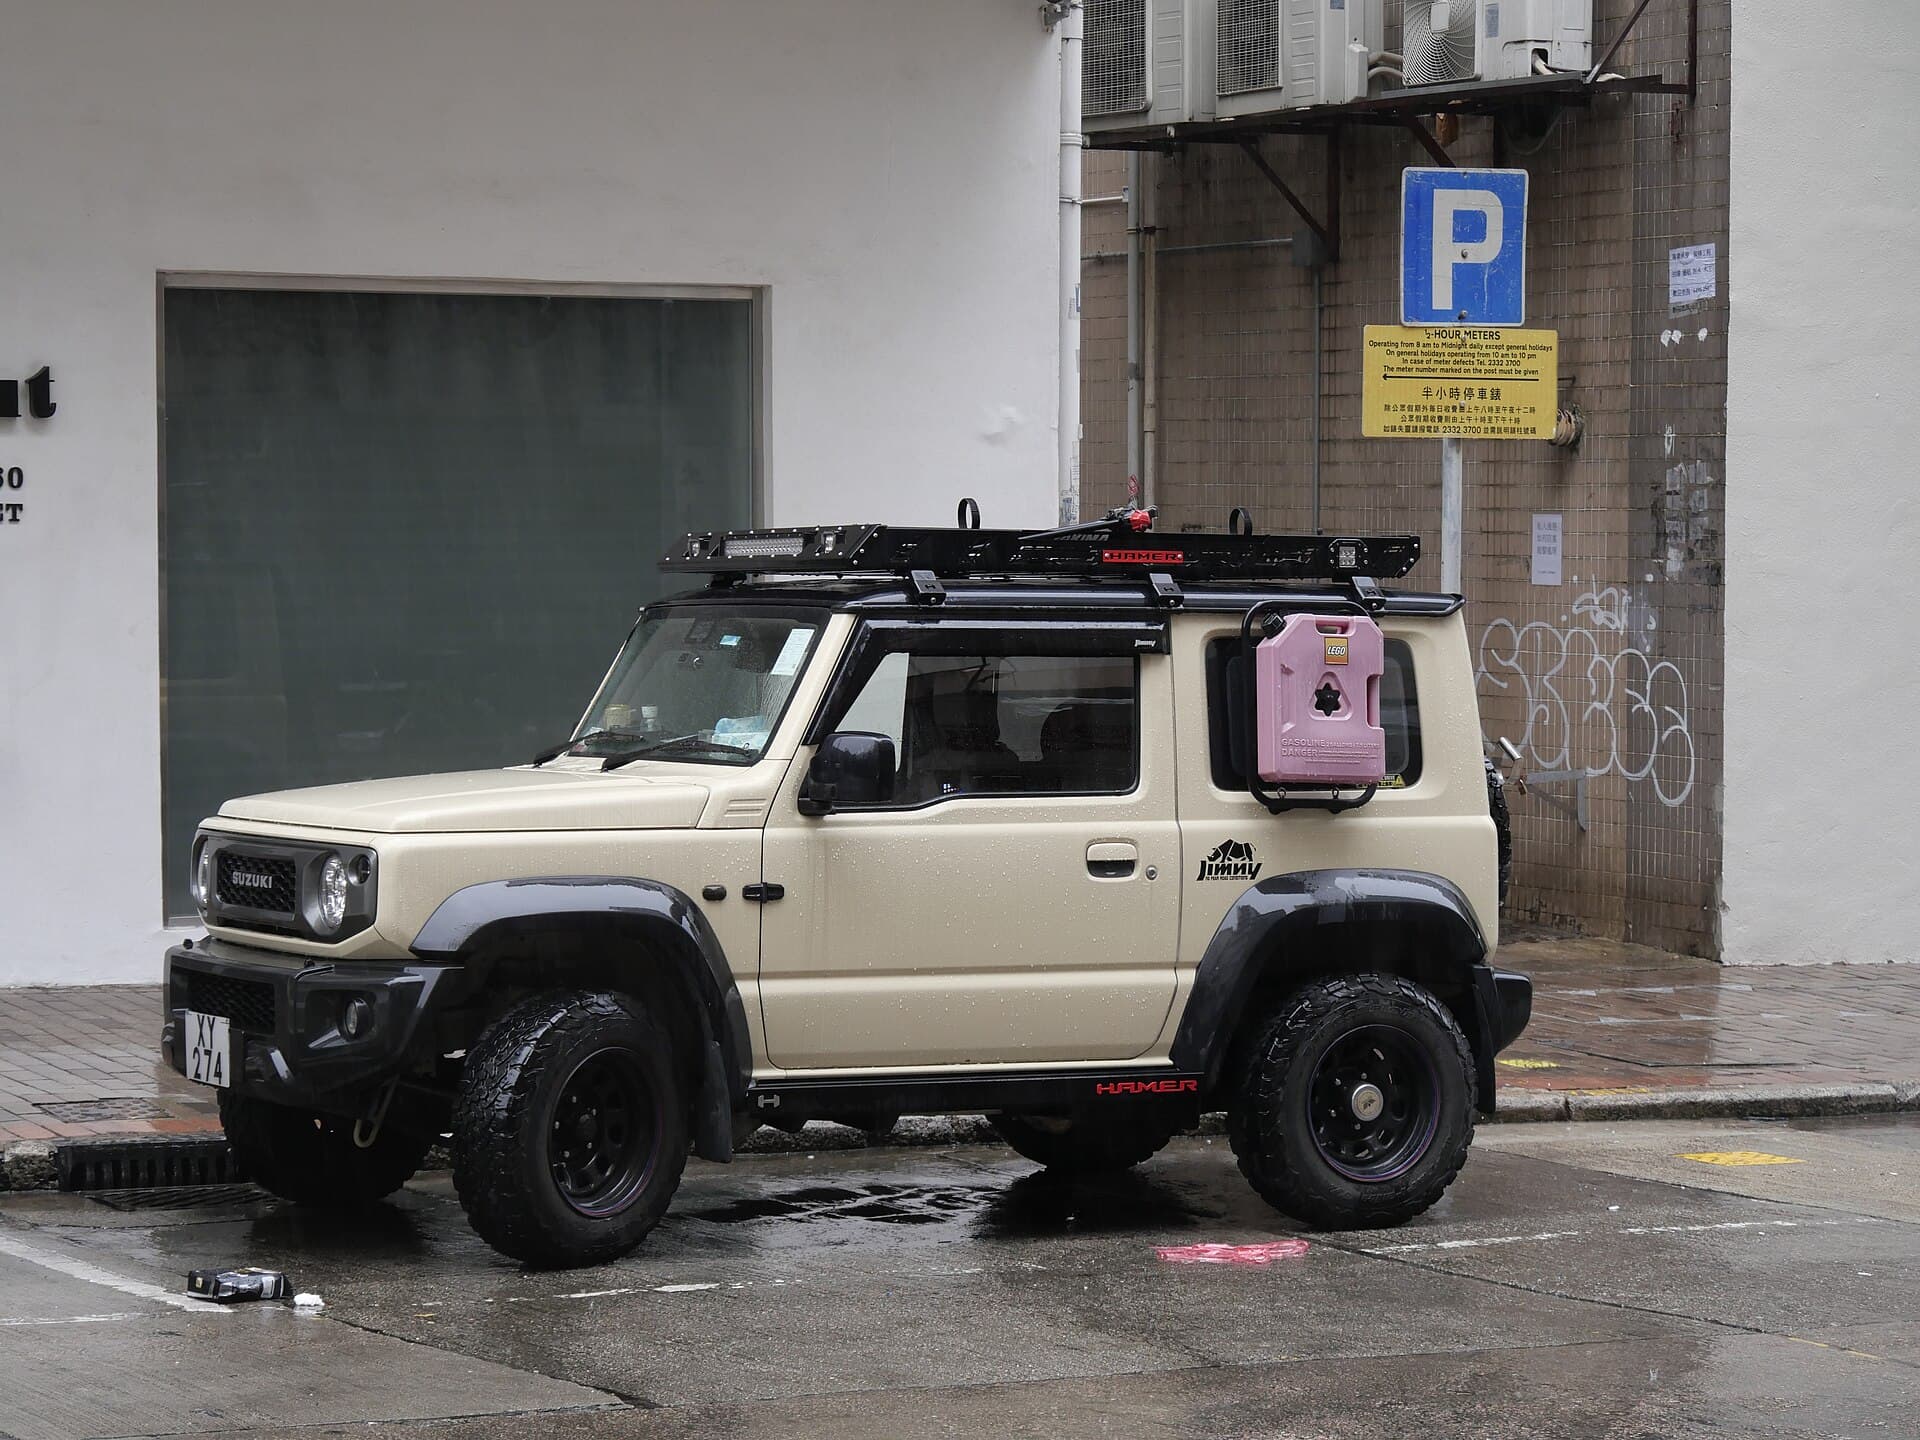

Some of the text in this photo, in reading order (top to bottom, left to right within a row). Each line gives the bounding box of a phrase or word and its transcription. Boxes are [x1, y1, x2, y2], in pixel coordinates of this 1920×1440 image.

[1432, 188, 1504, 310] P
[1464, 330, 1501, 341] METERS
[1369, 340, 1399, 349] Operating
[1400, 340, 1415, 348] from
[1441, 341, 1468, 350] Midnight
[1469, 342, 1484, 350] daily
[1528, 344, 1553, 352] holidays
[1420, 350, 1445, 358] holidays
[1452, 358, 1475, 366] defects
[1488, 359, 1504, 367] 2332
[1439, 366, 1462, 374] marked
[1422, 386, 1502, 401] 半小時停車錶
[1442, 426, 1461, 434] 2332
[1463, 426, 1482, 434] 3700
[0, 467, 24, 489] 0
[0, 503, 24, 522] T
[1109, 551, 1178, 561] HAMER
[1327, 646, 1346, 656] LEGO
[1281, 738, 1326, 748] GASOLINE
[1281, 748, 1318, 758] DANGER
[231, 871, 273, 889] SUZUKI
[196, 1014, 216, 1048] XY
[192, 1047, 222, 1084] 274
[1096, 1080, 1197, 1095] HAMER
